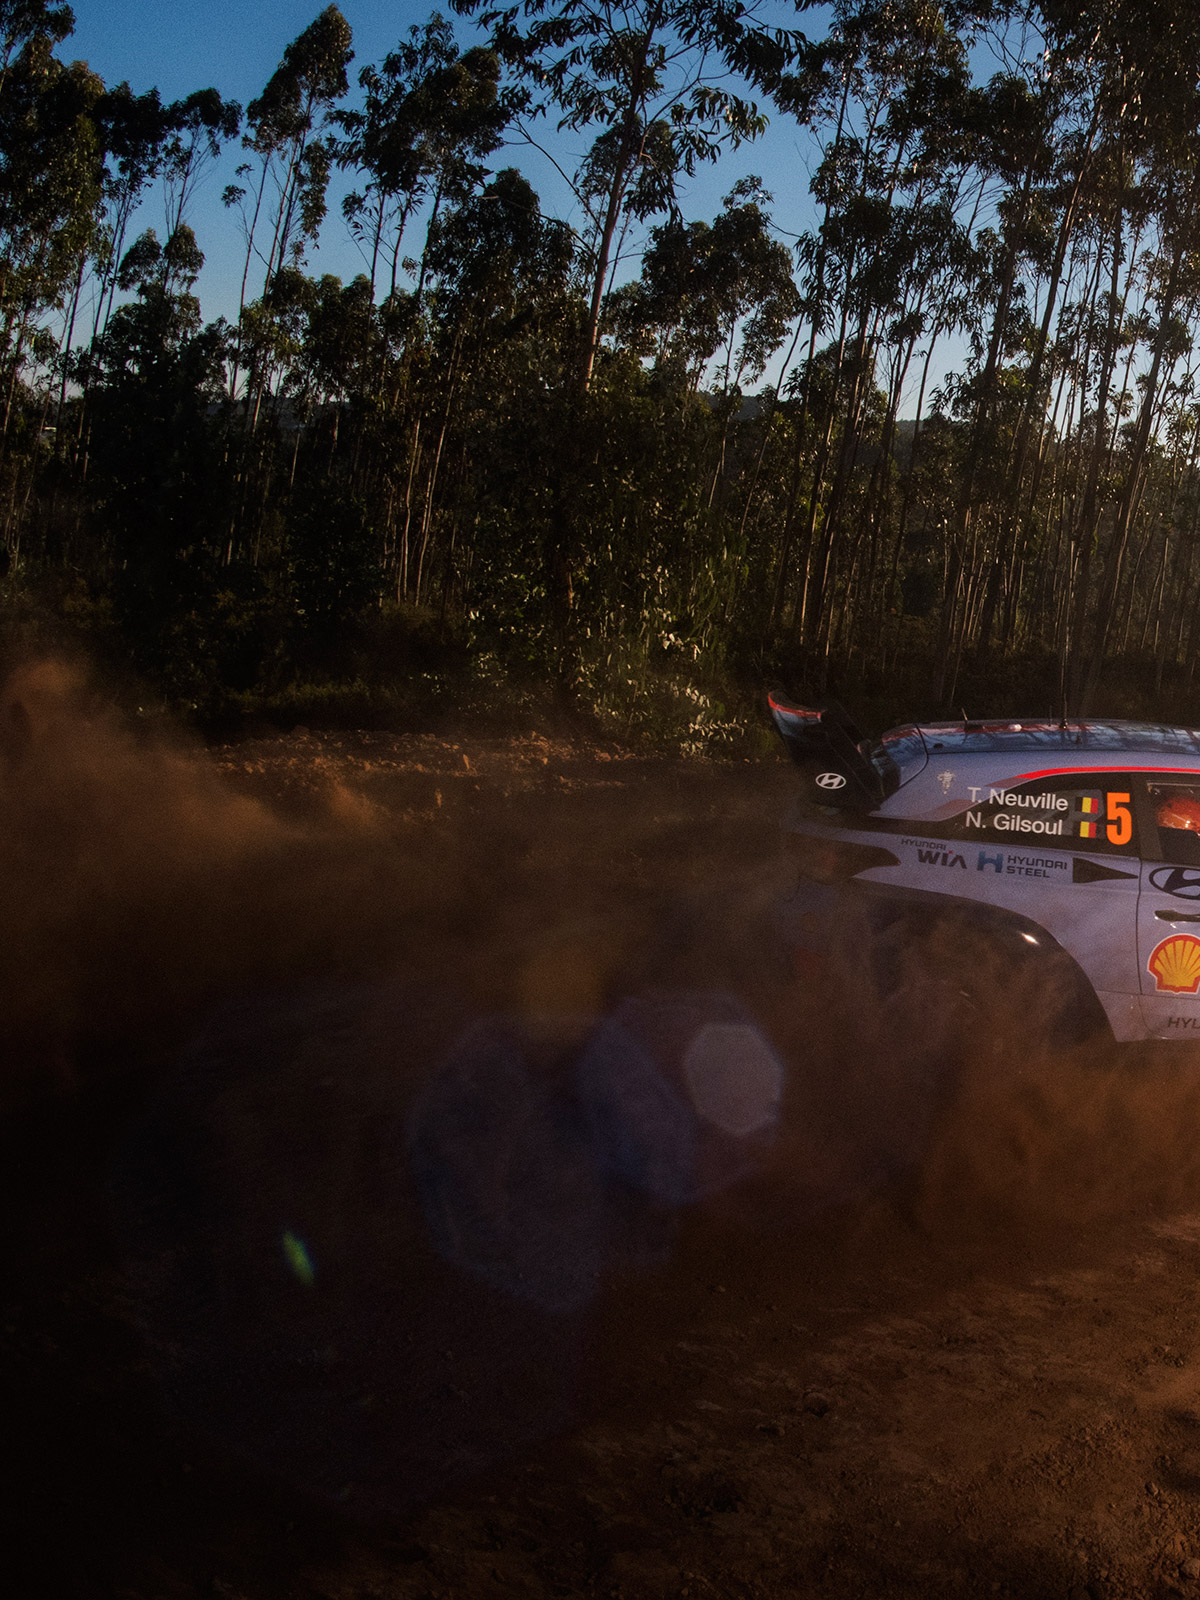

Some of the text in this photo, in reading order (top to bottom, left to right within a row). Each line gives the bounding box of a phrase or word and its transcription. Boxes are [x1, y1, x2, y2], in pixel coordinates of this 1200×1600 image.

[967, 786, 1069, 811] T. Neuville
[965, 811, 1063, 836] N. Gilsoul
[1106, 792, 1133, 845] 5
[901, 838, 947, 851] HYUNDAI
[917, 849, 967, 870] WIA
[1007, 855, 1068, 870] HYUNDAI
[1006, 866, 1050, 879] STEEL
